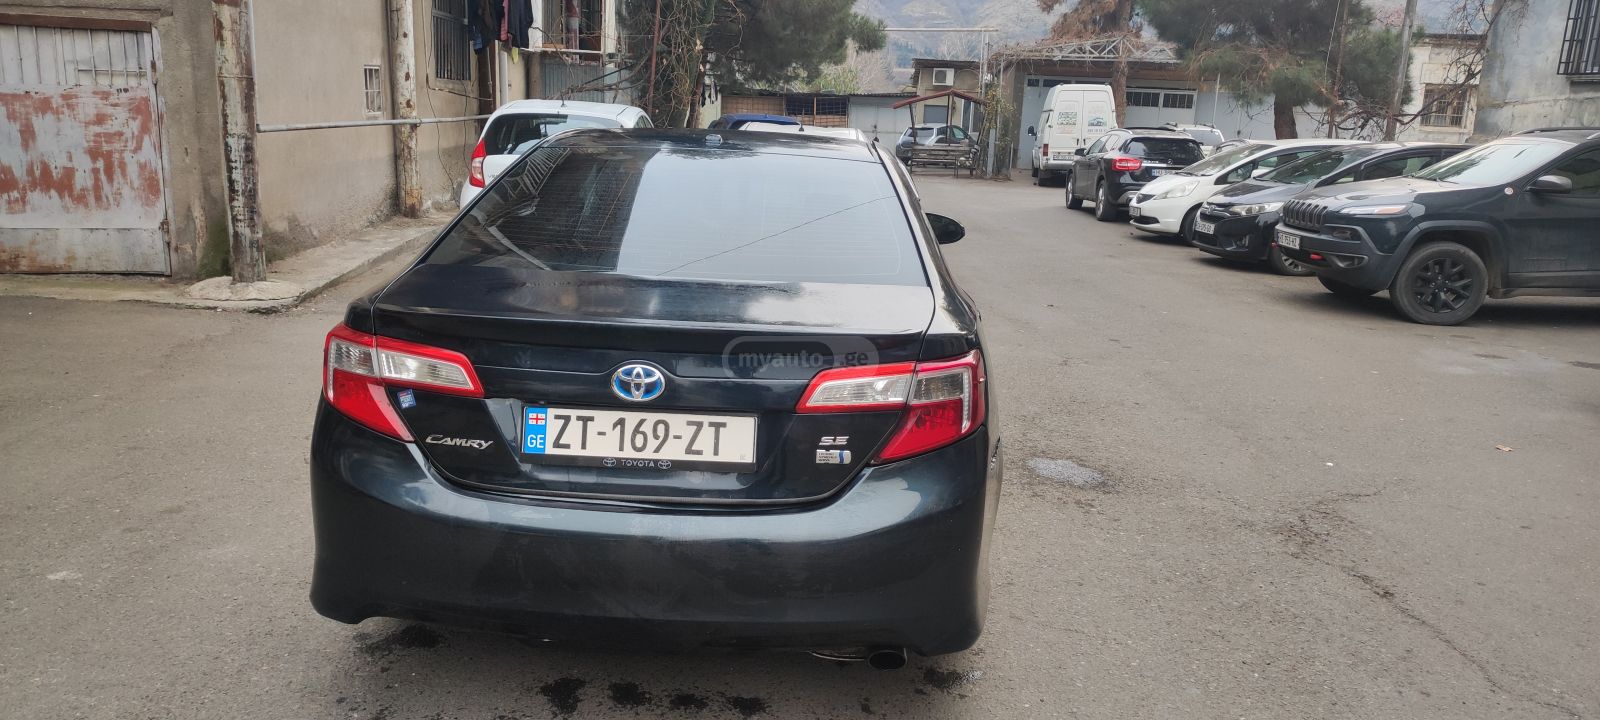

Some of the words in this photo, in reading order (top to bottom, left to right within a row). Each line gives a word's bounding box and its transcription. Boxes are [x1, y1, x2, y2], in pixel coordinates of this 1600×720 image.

[425, 434, 494, 450] CAMRY
[527, 434, 545, 449] GE
[552, 414, 728, 457] ZT-169-ZT
[819, 436, 850, 446] SE
[621, 459, 655, 468] TOYOTA
